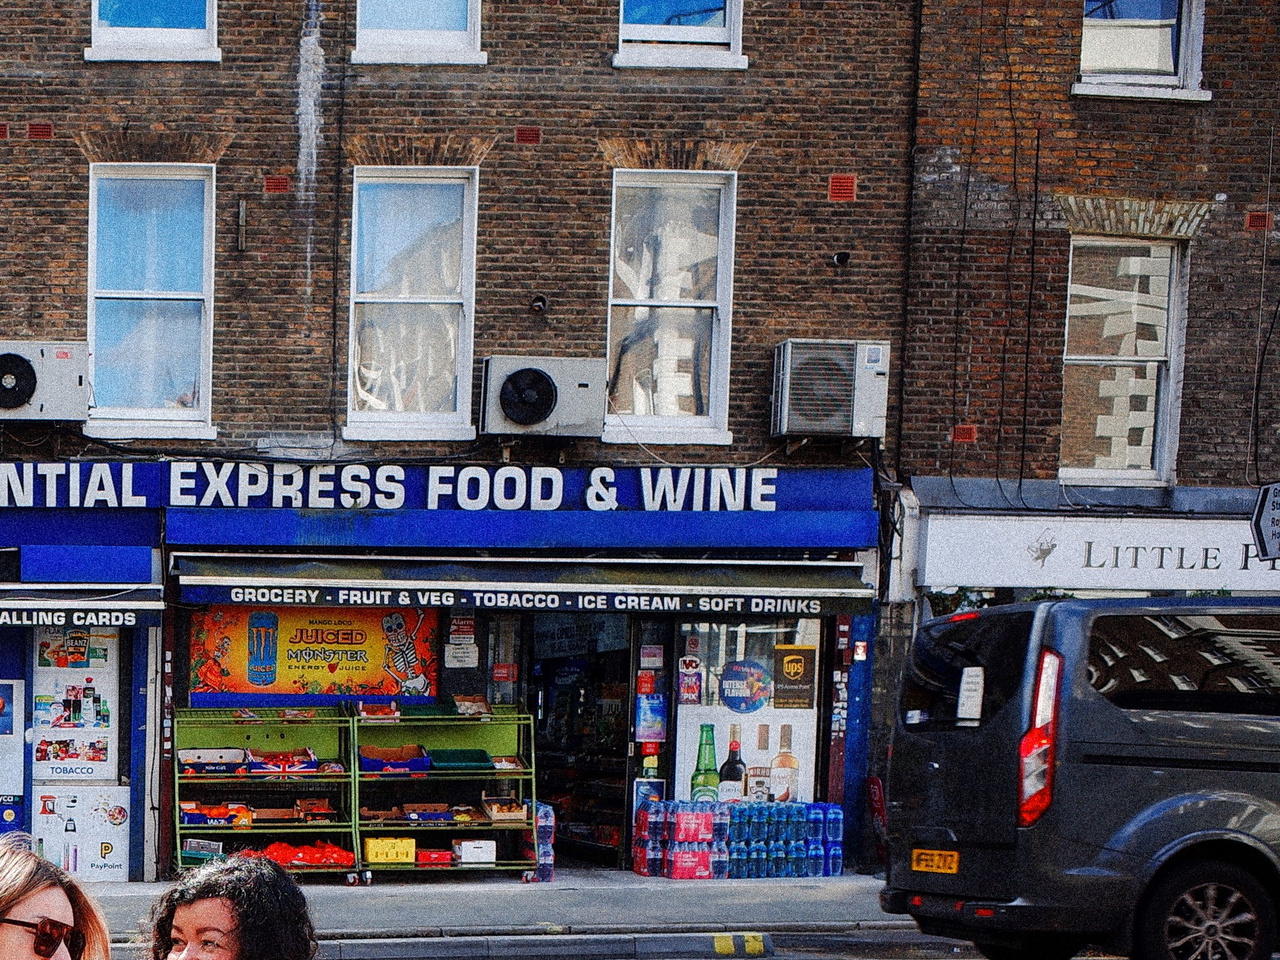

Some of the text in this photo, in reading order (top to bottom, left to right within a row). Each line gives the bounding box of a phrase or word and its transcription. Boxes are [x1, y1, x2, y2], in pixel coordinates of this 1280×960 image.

[170, 462, 405, 509] EXPRESS
[428, 466, 564, 511] FOOD
[586, 467, 618, 511] &
[640, 468, 778, 512] WINE
[1082, 541, 1222, 570] LITTLE
[230, 589, 319, 603] GROCERY
[338, 590, 392, 605] FRUIT
[398, 591, 411, 605] &
[417, 592, 455, 606] VEG
[473, 592, 559, 609] TOBACCO
[578, 595, 608, 609] ICE
[614, 595, 681, 610] CREAM
[699, 597, 744, 612] SOFT
[750, 598, 821, 613] DRINKS
[72, 612, 136, 626] CARDS
[288, 628, 367, 645] JUICED
[287, 647, 368, 663] MONSTER
[50, 767, 94, 775] TOBACCO
